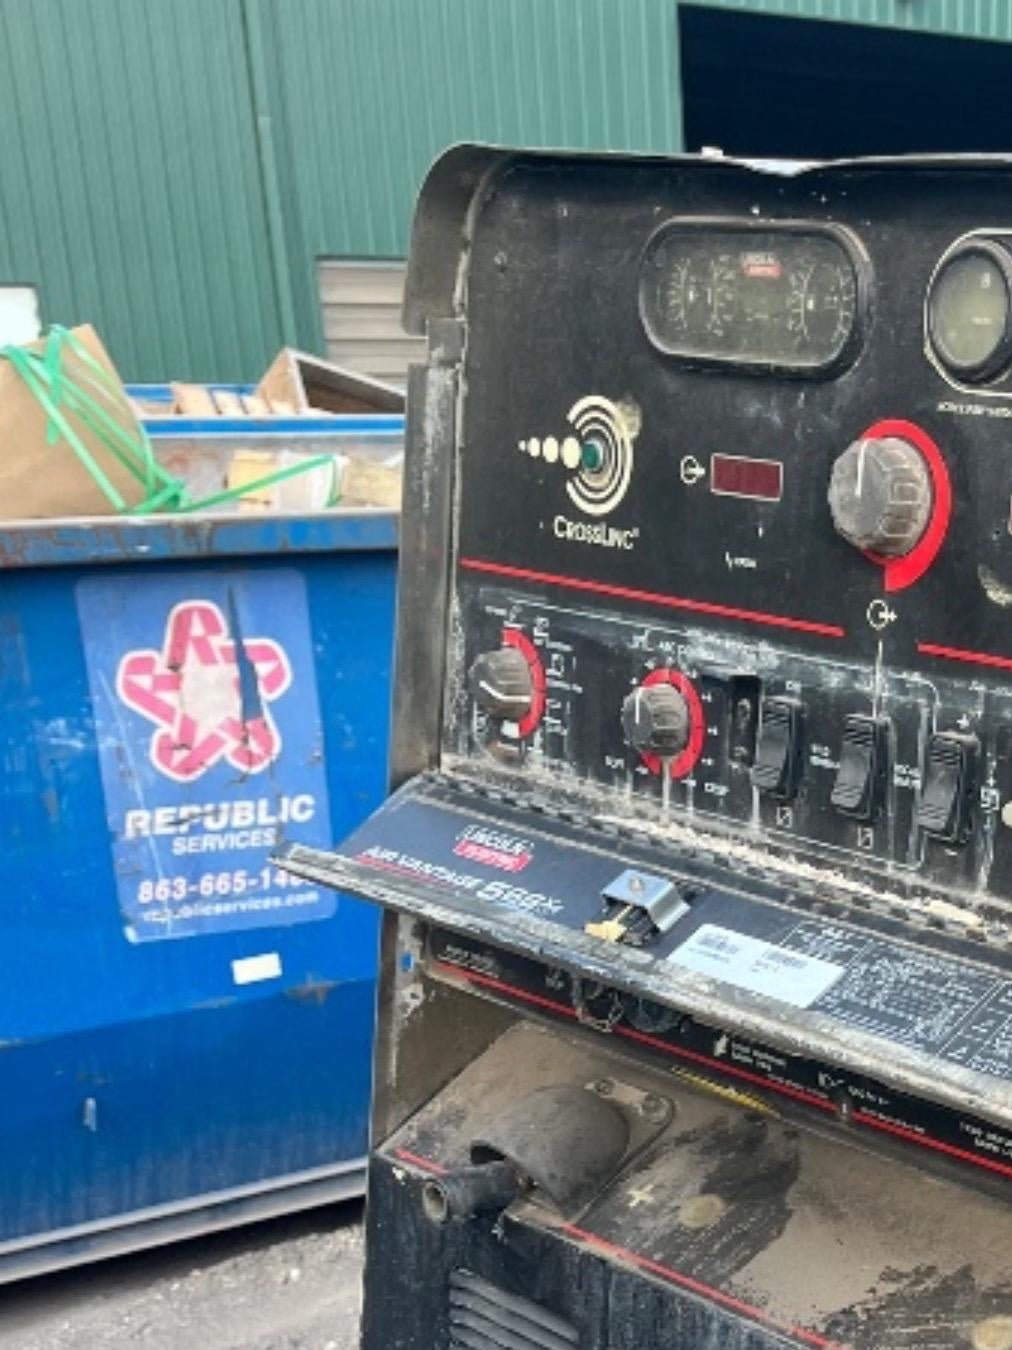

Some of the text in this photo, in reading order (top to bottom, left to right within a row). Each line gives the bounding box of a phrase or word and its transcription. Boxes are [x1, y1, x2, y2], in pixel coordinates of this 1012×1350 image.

[124, 793, 316, 841] REPUBLIC
[171, 826, 277, 857] SERVICES
[136, 865, 317, 905] 863-665-14
